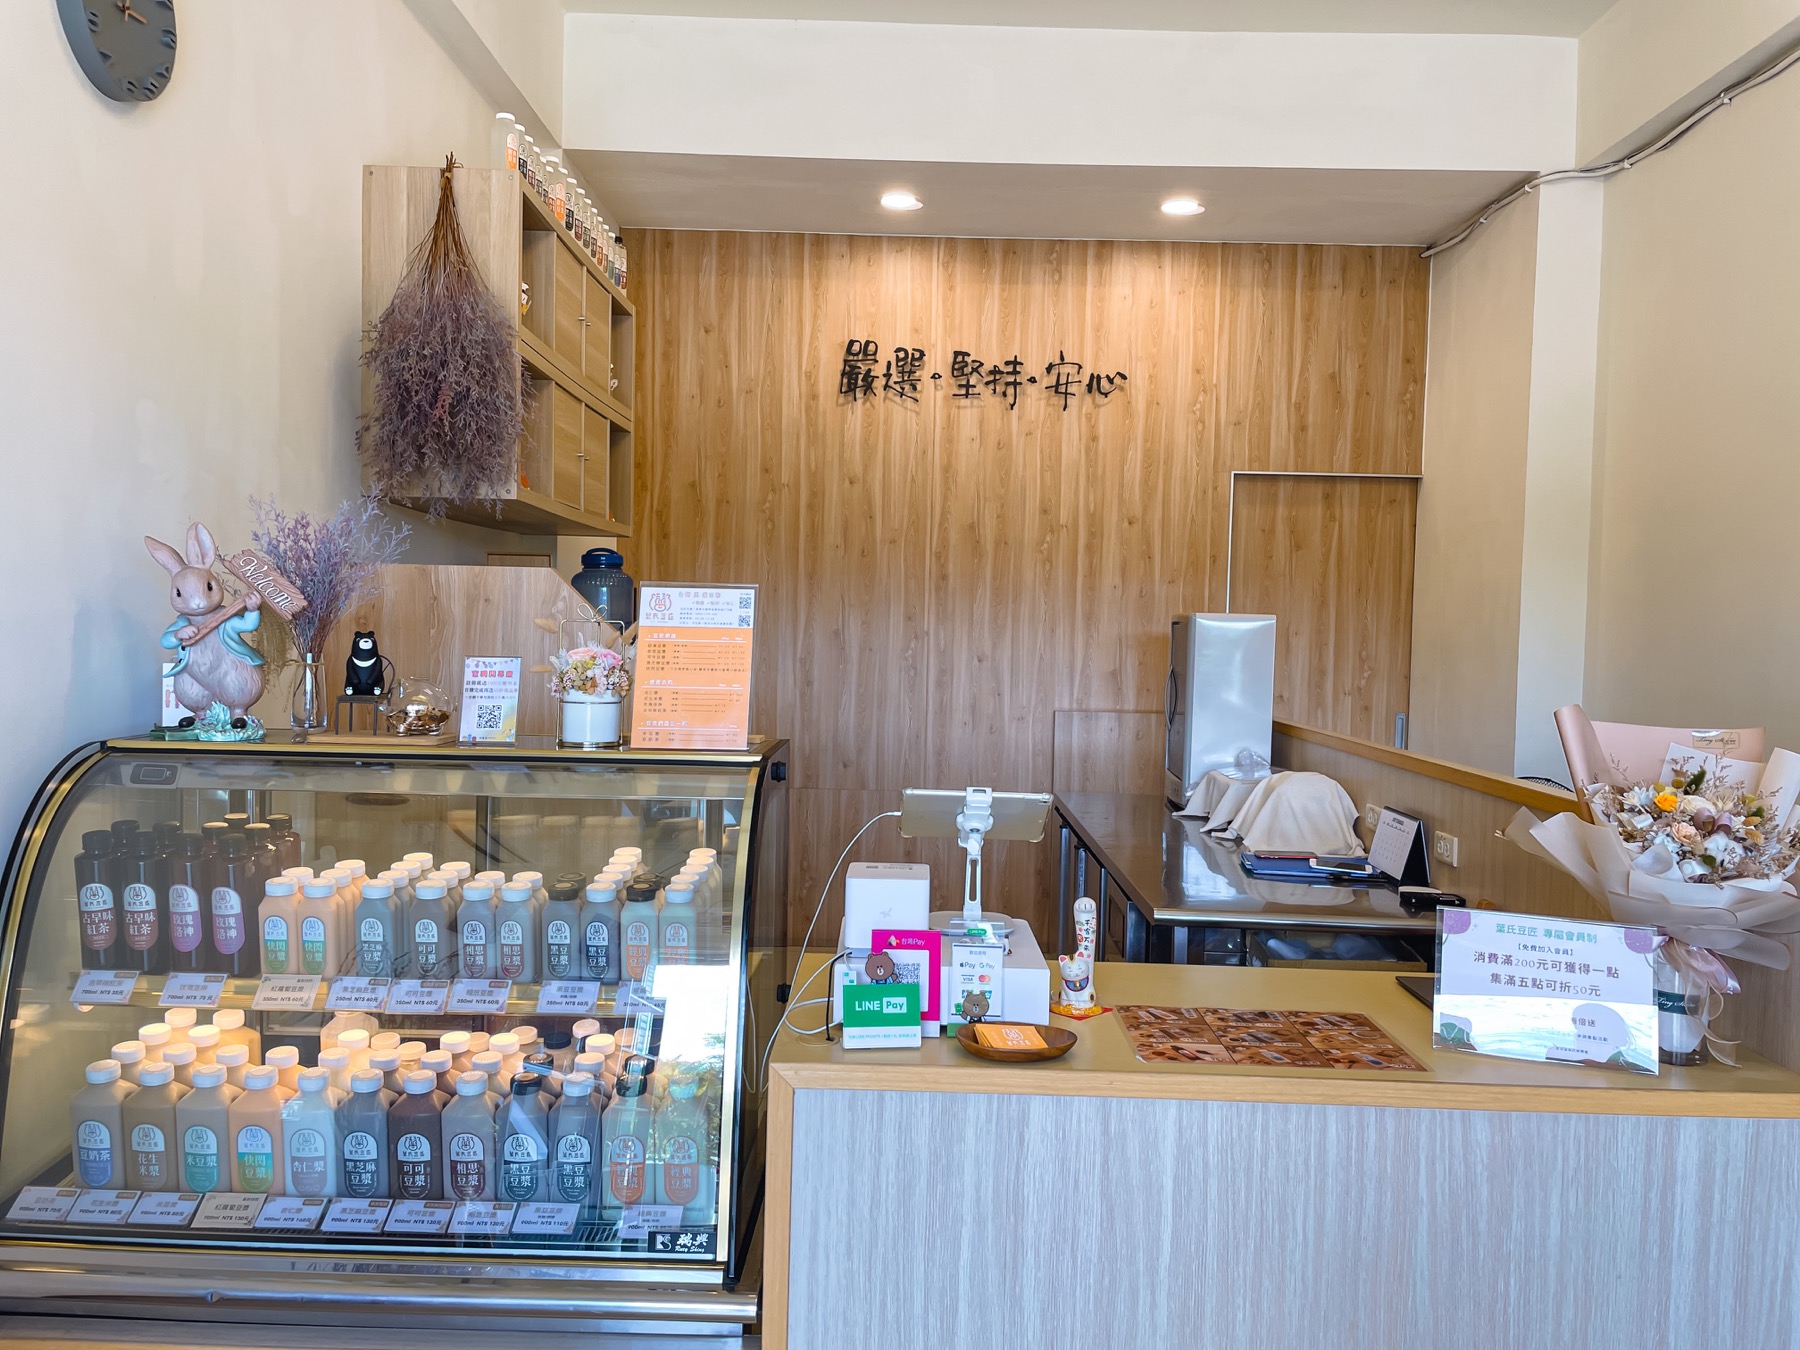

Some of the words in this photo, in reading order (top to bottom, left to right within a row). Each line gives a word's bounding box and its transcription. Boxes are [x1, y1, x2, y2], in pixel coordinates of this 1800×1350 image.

[240, 556, 297, 612] Welcome
[82, 912, 114, 924] 古早味
[125, 912, 156, 923] 古早味
[173, 914, 194, 926] 玫瑰
[216, 917, 237, 928] 玫瑰
[86, 924, 110, 935] 紅茶
[129, 924, 151, 935] 紅茶
[174, 926, 195, 938] 洛神
[217, 927, 238, 940] 洛神
[1496, 923, 1539, 938] 葉氏豆匠
[1543, 928, 1597, 944] 專屬會員制
[267, 941, 285, 951] 快閃
[304, 942, 323, 952] 快閃
[418, 945, 436, 954] 可可
[465, 945, 484, 955] 相思
[503, 945, 521, 956] 相思
[550, 945, 568, 955] 黑豆
[588, 946, 607, 956] 黑豆
[268, 952, 286, 961] 豆漿
[306, 952, 323, 961] 豆漿
[364, 951, 382, 961] 豆漿
[629, 947, 647, 957] 經典
[418, 955, 437, 964] 豆漿
[466, 956, 484, 965] 豆漿
[503, 956, 521, 966] 豆漿
[551, 956, 569, 965] 豆漿
[589, 957, 607, 967] 豆漿
[629, 957, 647, 967] 豆漿
[1473, 951, 1620, 979] 消費滿200元可獲得一點
[964, 961, 976, 970] Pay
[985, 962, 996, 970] Pay
[1490, 972, 1601, 997] 集滿五點可折50元
[855, 1000, 881, 1011] LINE
[886, 1000, 905, 1010] Pay
[79, 1150, 111, 1161] 豆奶茶
[138, 1153, 159, 1164] 花生
[186, 1155, 218, 1167] 米豆漿
[244, 1155, 266, 1167] 快閃
[139, 1165, 160, 1177] 米漿
[292, 1161, 326, 1172] 杏仁漿
[346, 1161, 377, 1173] 黑芝麻
[403, 1163, 425, 1175] 可可
[456, 1163, 479, 1174] 相思
[510, 1163, 532, 1174] 黑豆
[563, 1164, 585, 1176] 黑豆
[671, 1166, 692, 1178] 經典
[245, 1167, 267, 1179] 豆漿
[350, 1173, 372, 1185] 豆漿
[403, 1175, 426, 1187] 豆漿
[456, 1175, 479, 1186] 豆漿
[510, 1176, 532, 1187] 豆漿
[563, 1176, 585, 1188] 豆漿
[671, 1178, 692, 1190] 豆漿
